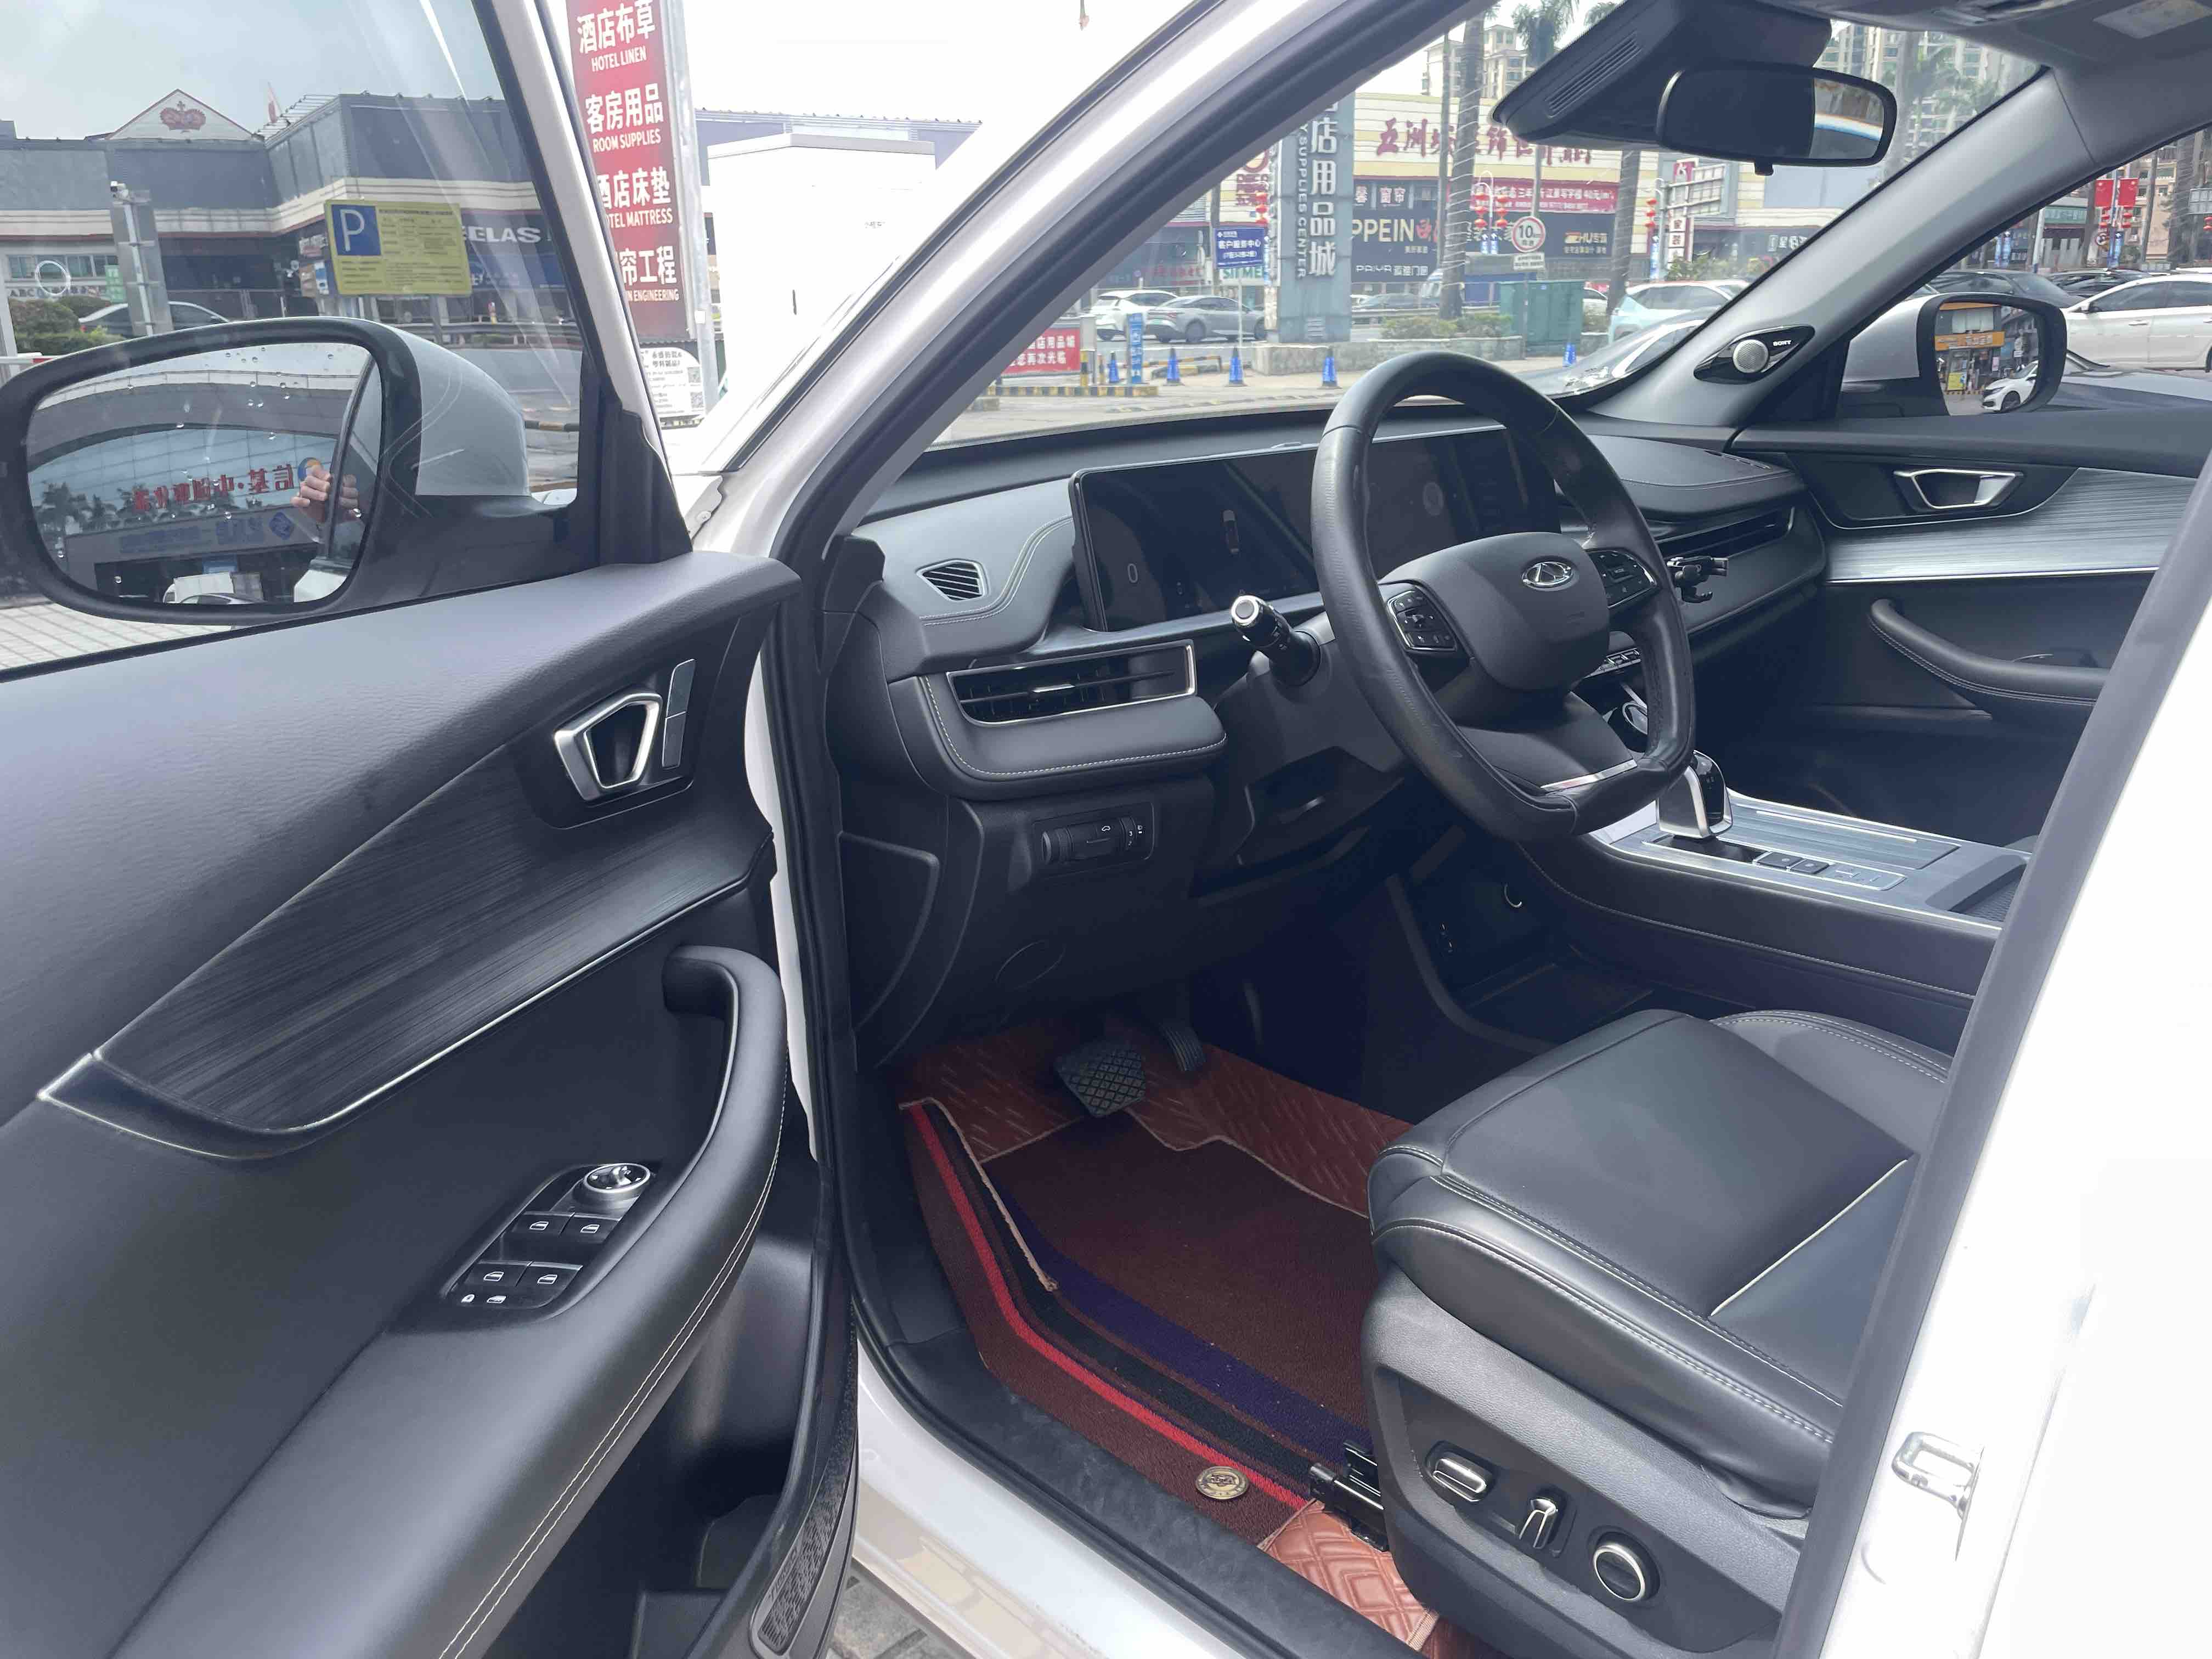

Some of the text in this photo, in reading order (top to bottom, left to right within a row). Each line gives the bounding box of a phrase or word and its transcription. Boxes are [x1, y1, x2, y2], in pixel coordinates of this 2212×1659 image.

[577, 0, 655, 54] 酒店布草
[591, 46, 647, 72] HOTEL LINEN
[585, 83, 664, 134] 客房用品
[592, 128, 661, 153] ROOM SUPPLIES
[1299, 137, 1308, 212] SUPPLIES
[1311, 101, 1336, 276] 店用品城
[340, 209, 365, 252] P
[625, 207, 673, 227] MATTRESS
[1519, 225, 1533, 238] 10
[615, 246, 677, 286] 帘工程
[1298, 217, 1307, 277] CENTER
[633, 289, 679, 302] ENGINEERING
